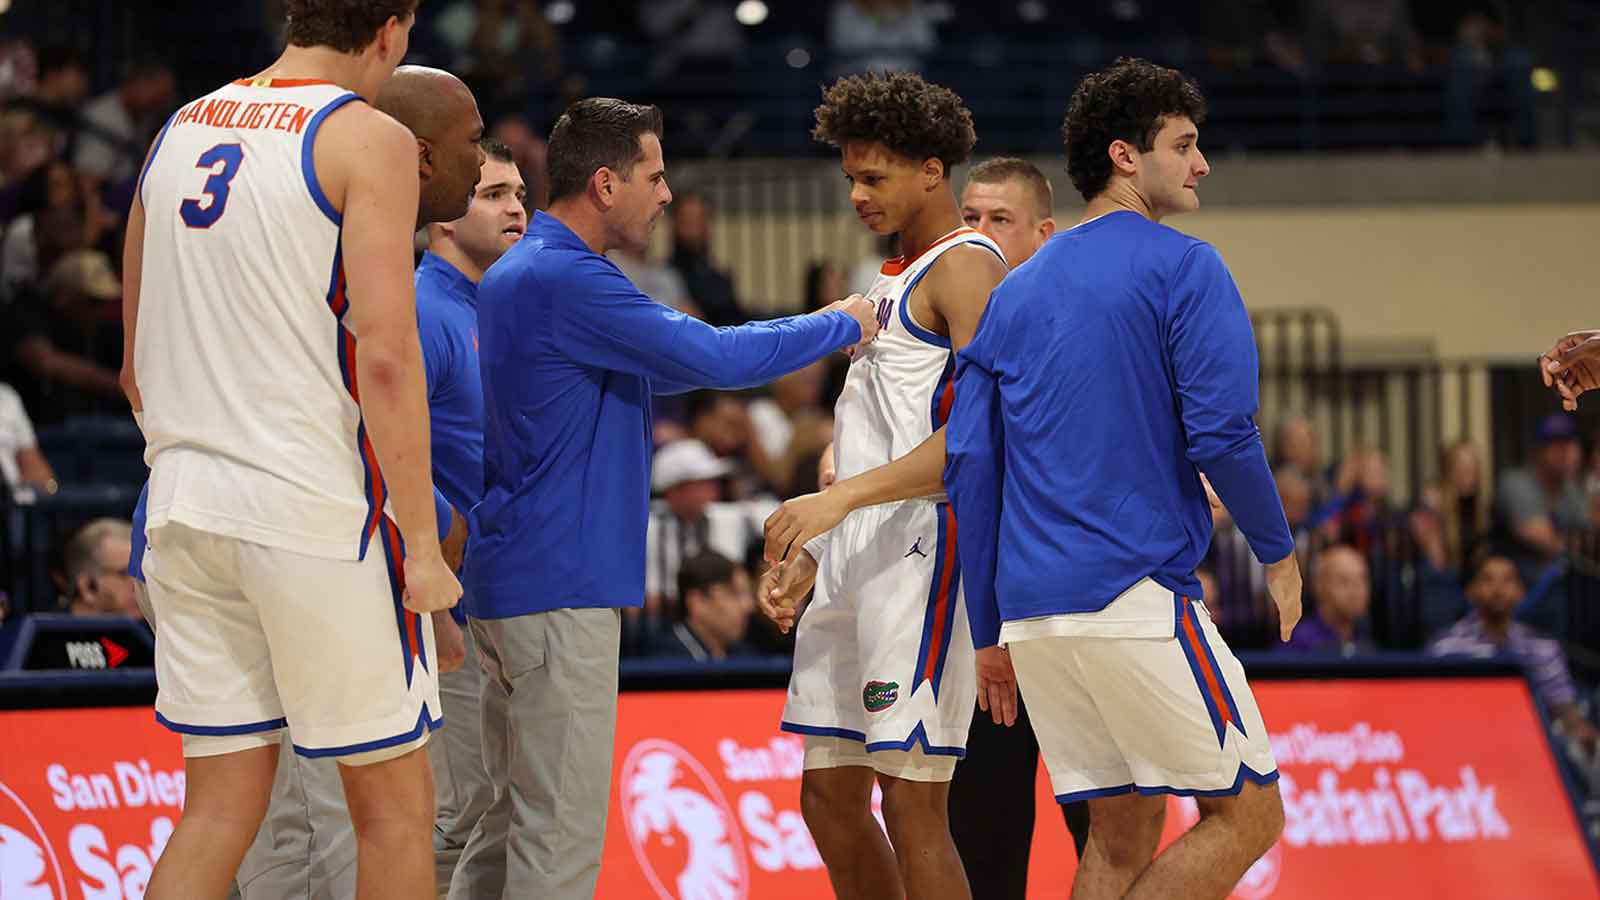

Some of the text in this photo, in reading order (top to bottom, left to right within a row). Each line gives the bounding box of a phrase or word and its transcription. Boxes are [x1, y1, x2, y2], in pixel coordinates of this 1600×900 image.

[178, 142, 244, 229] 3
[47, 762, 120, 813] San
[1396, 764, 1512, 844] Park
